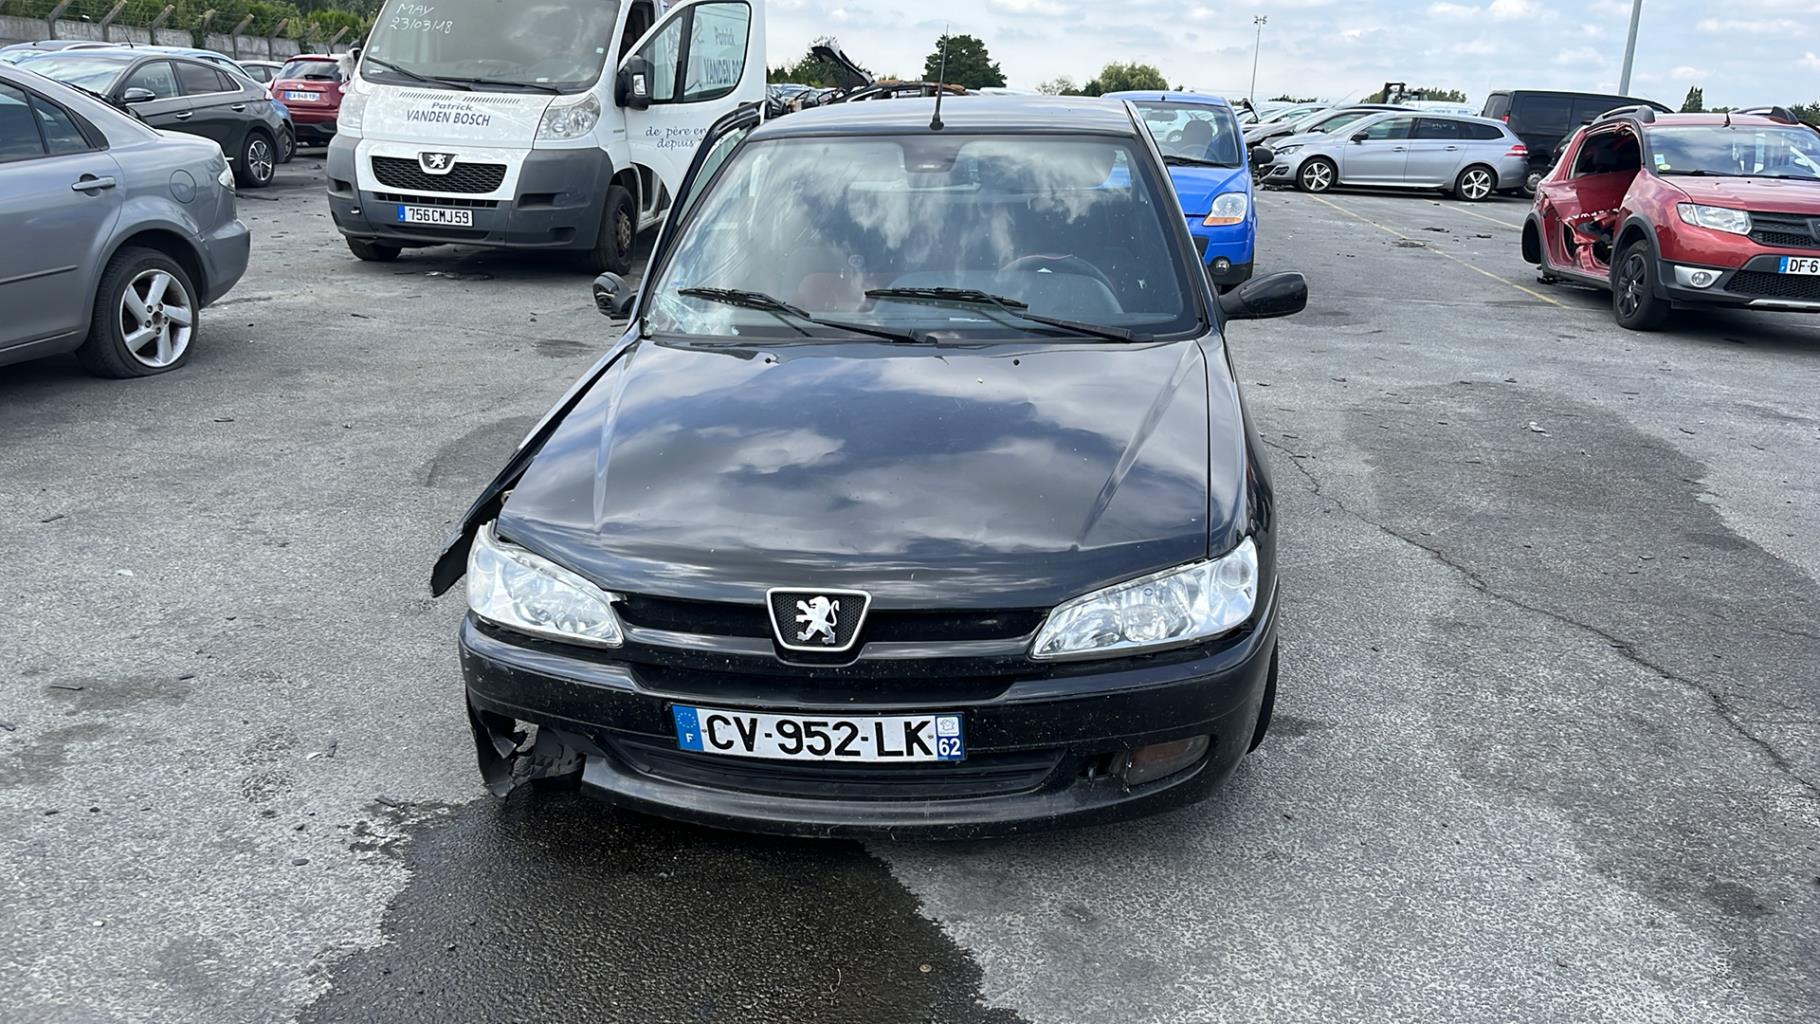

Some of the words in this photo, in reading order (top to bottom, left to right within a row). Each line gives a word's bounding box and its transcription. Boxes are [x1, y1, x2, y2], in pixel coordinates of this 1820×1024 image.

[431, 102, 474, 112] Patrick
[407, 110, 452, 124] VANDEN
[453, 112, 491, 127] BOSCH
[645, 126, 661, 136] de
[656, 138, 695, 151] depuis
[685, 732, 694, 743] F
[705, 714, 933, 757] CV-952-LK
[938, 738, 961, 756] 62
